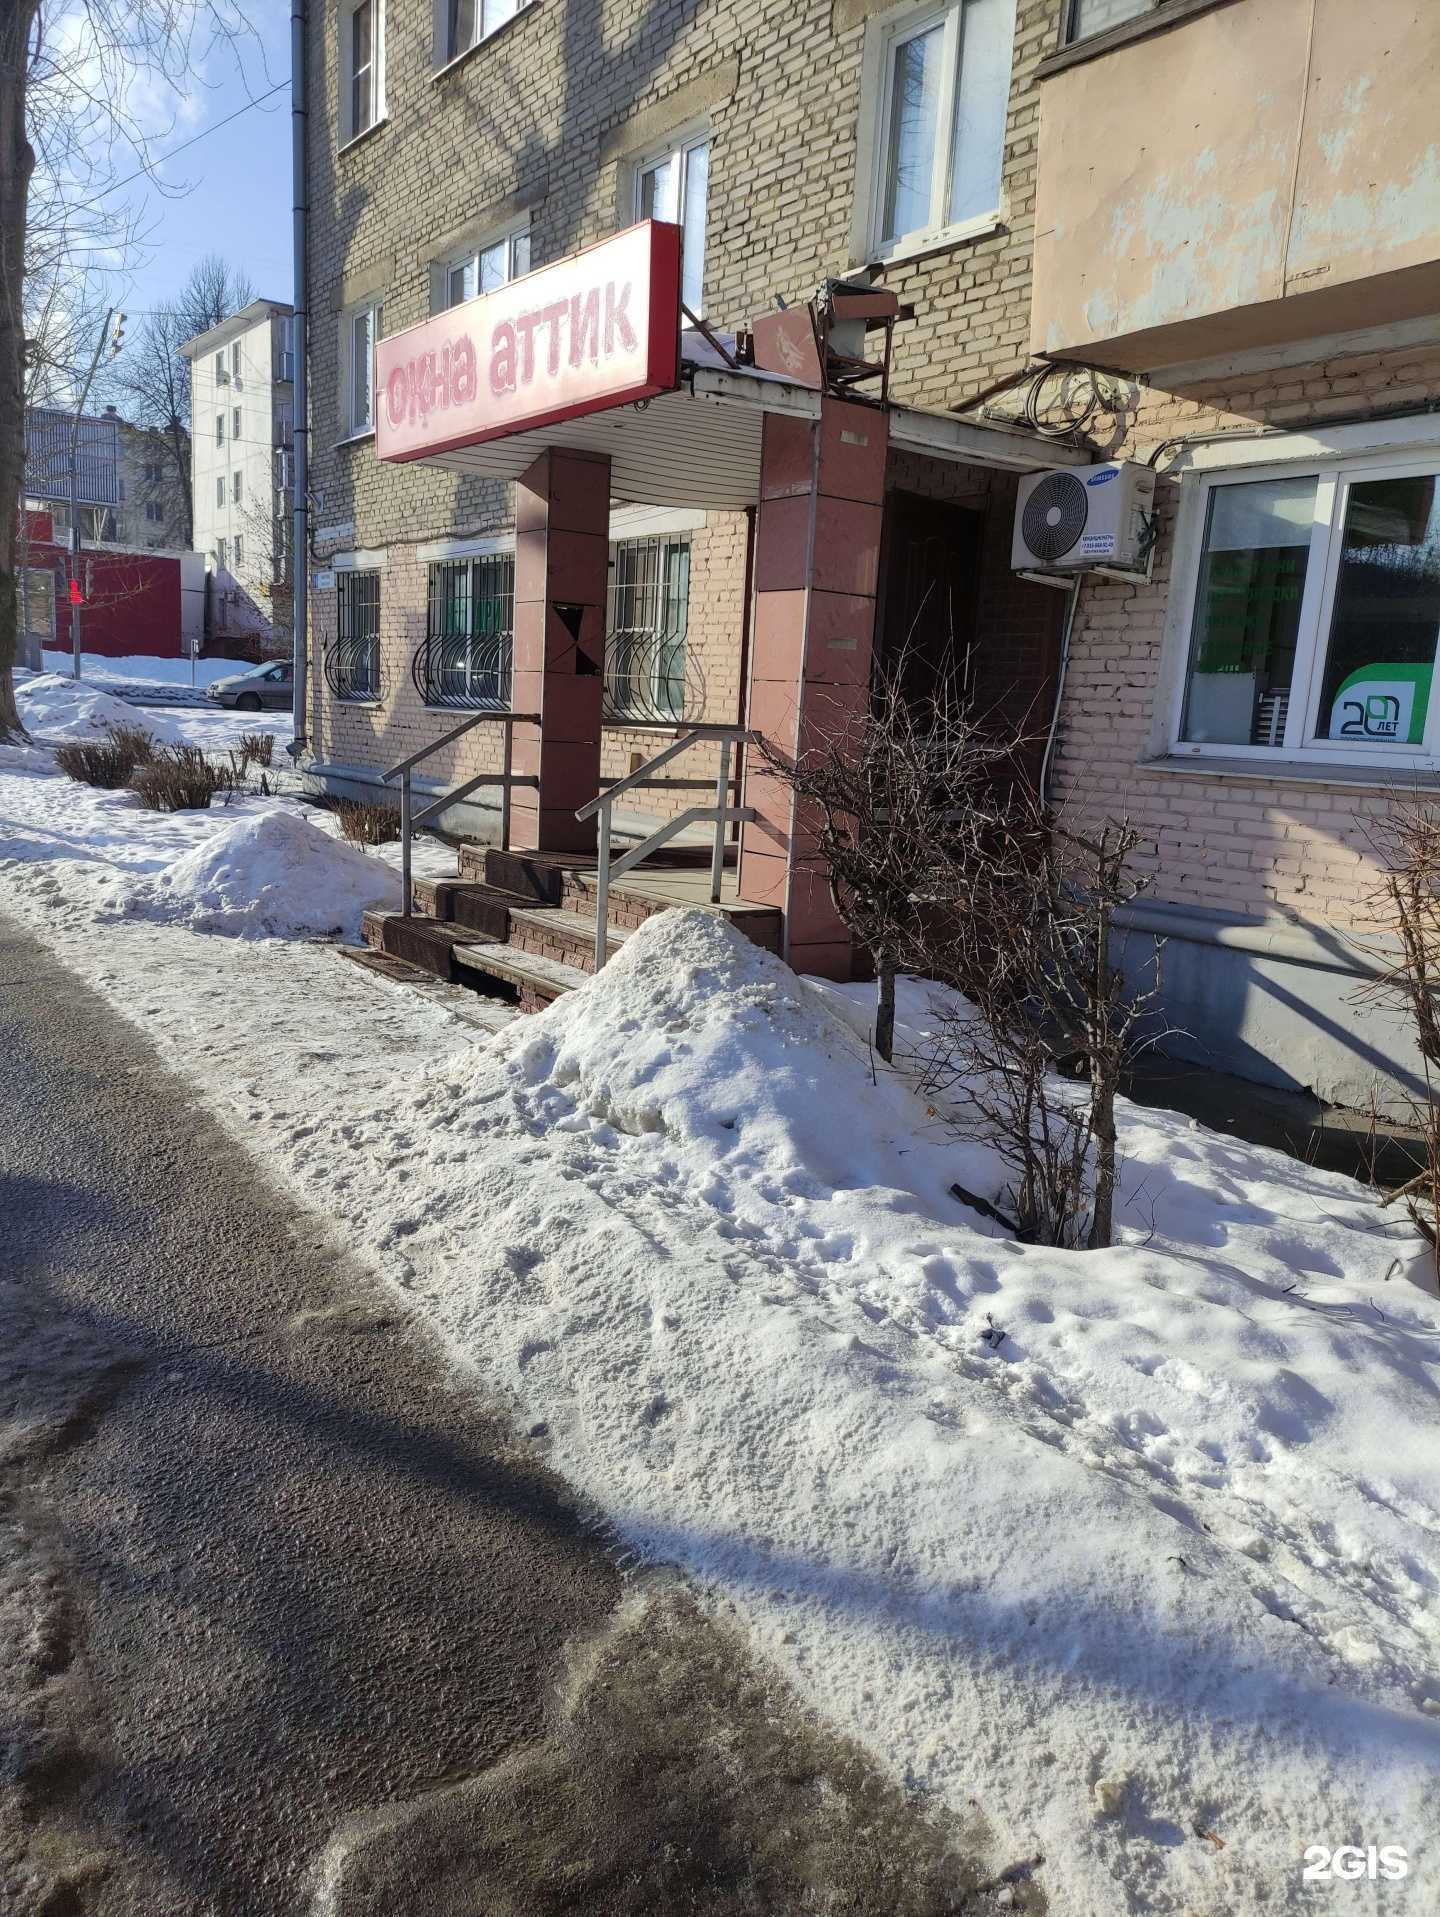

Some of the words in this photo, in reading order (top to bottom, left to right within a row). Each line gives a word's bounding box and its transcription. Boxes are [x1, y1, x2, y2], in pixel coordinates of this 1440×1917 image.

[489, 281, 638, 395] аттик
[1340, 695, 1400, 737] 20
[1377, 721, 1399, 732] ЛЕТ
